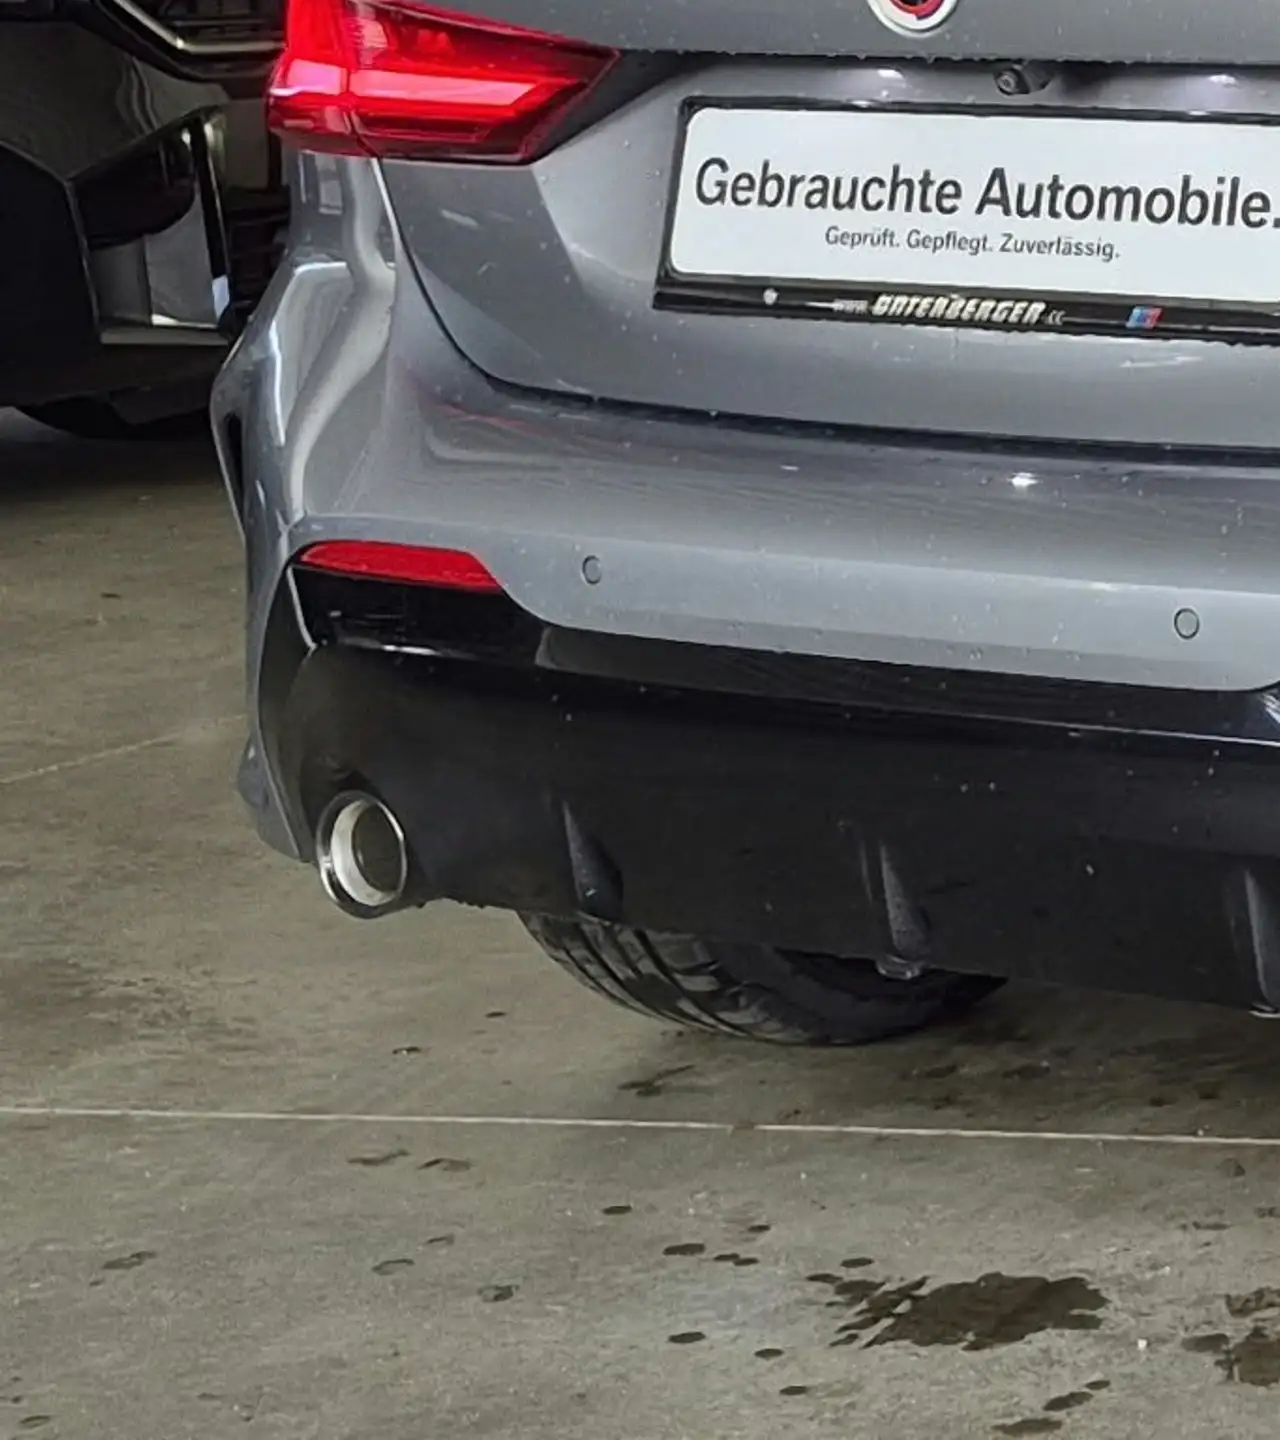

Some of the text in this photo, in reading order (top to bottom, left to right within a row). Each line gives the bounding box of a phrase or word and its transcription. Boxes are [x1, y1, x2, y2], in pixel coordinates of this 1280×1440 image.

[695, 156, 963, 215] Gebrauchte
[825, 225, 1121, 263] Geprüft. Gepflegt. Zuverlässig.
